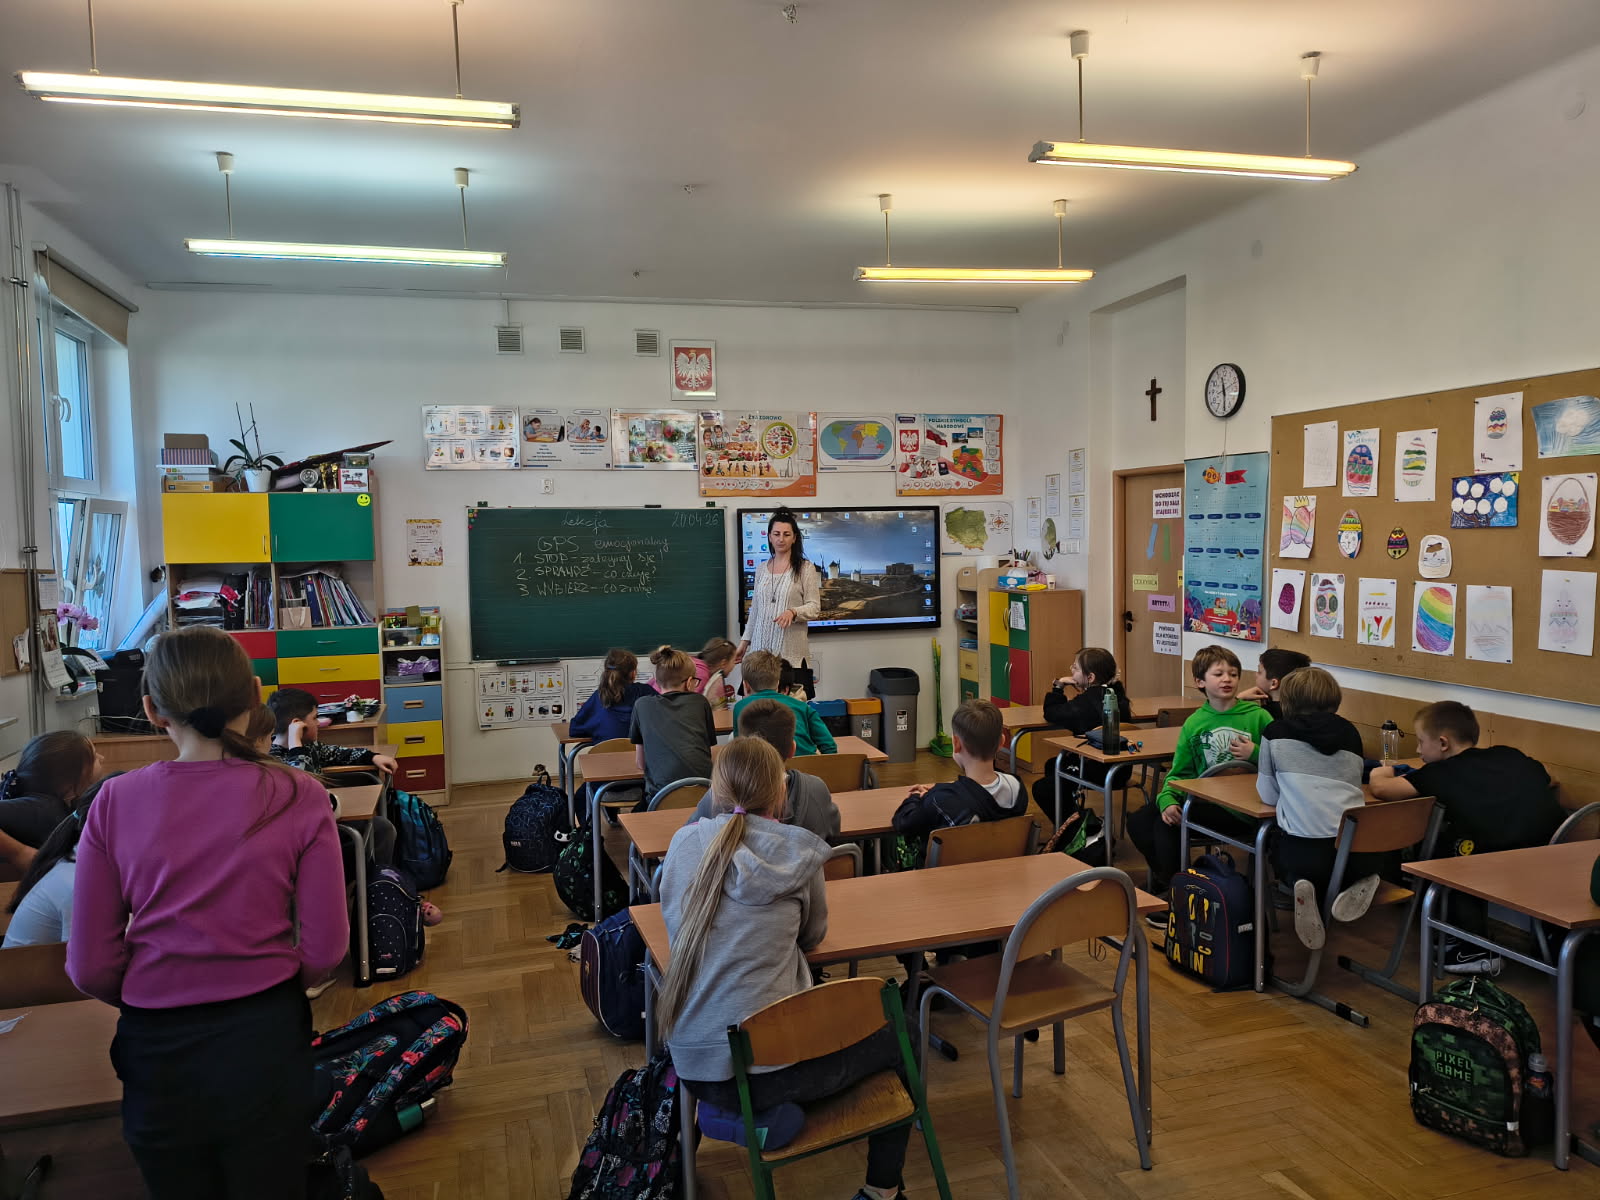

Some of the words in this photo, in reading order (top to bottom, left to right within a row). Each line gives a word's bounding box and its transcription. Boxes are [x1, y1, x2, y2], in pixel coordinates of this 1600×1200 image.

[537, 535, 580, 553] GPS
[1436, 1051, 1473, 1071] PIXEL
[1435, 1062, 1473, 1083] GAME
